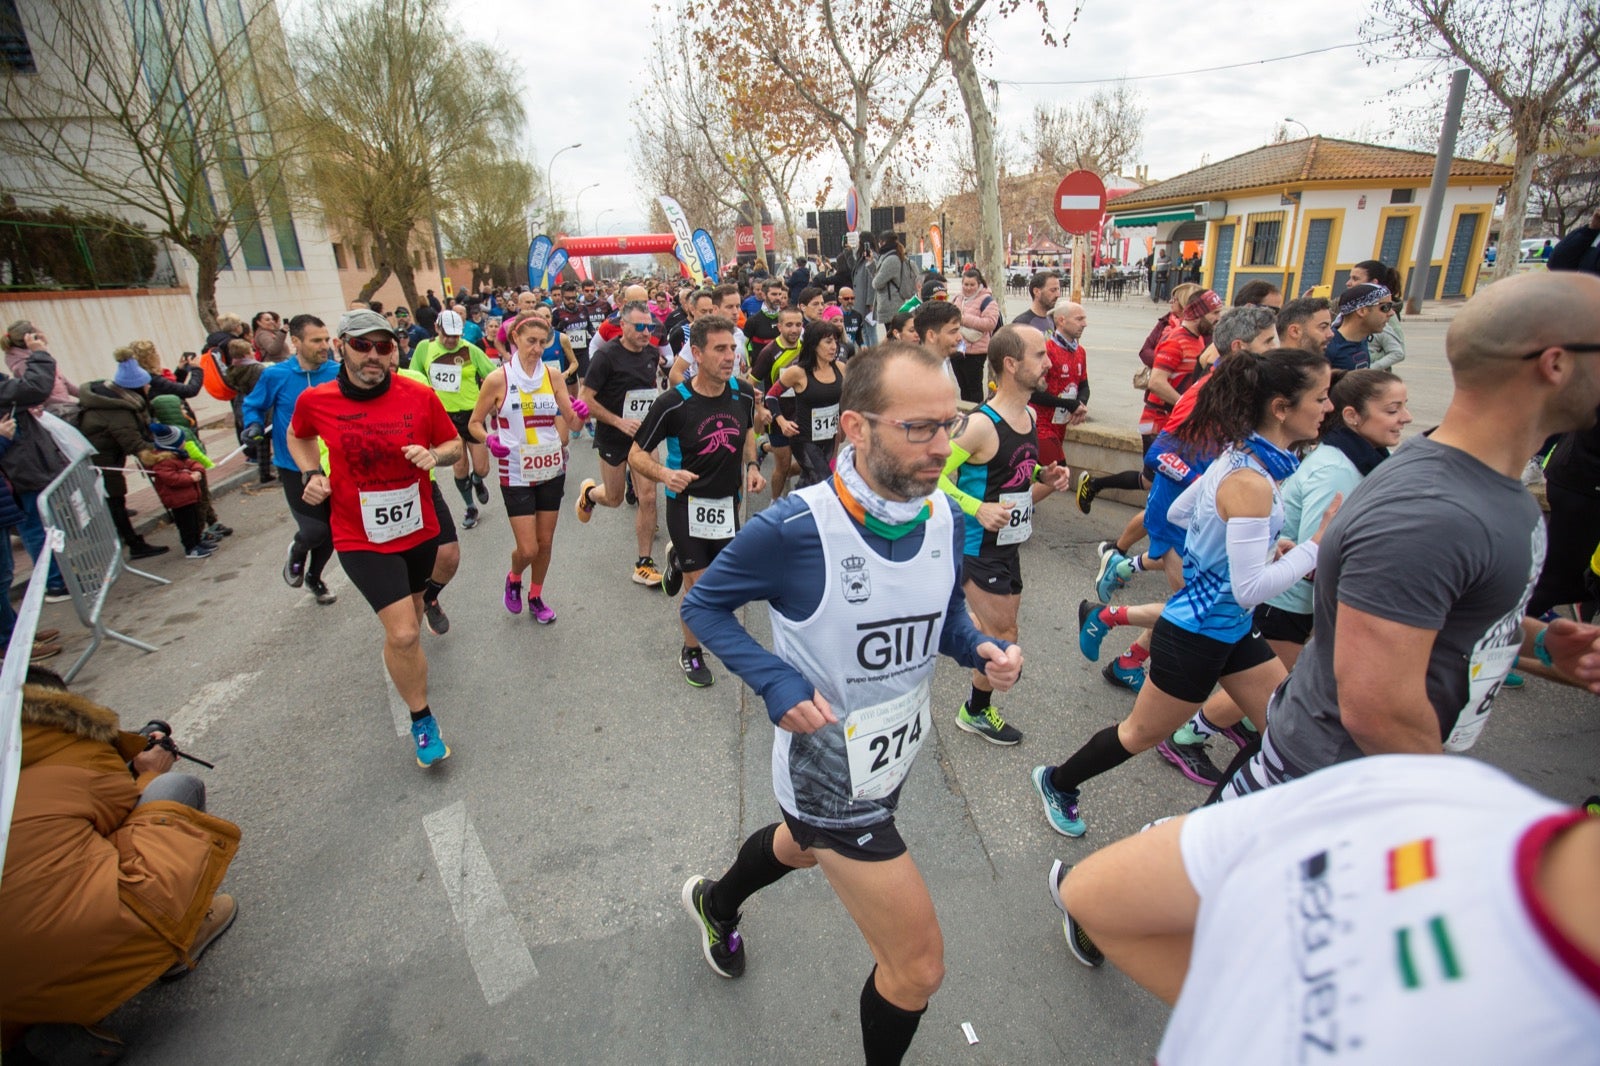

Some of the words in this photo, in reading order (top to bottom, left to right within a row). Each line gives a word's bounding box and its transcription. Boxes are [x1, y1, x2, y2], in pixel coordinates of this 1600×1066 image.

[435, 372, 456, 383] 420
[630, 399, 655, 412] 877
[523, 452, 561, 470] 2085
[375, 500, 414, 525] 567
[695, 506, 726, 525] 865
[869, 711, 922, 774] 274
